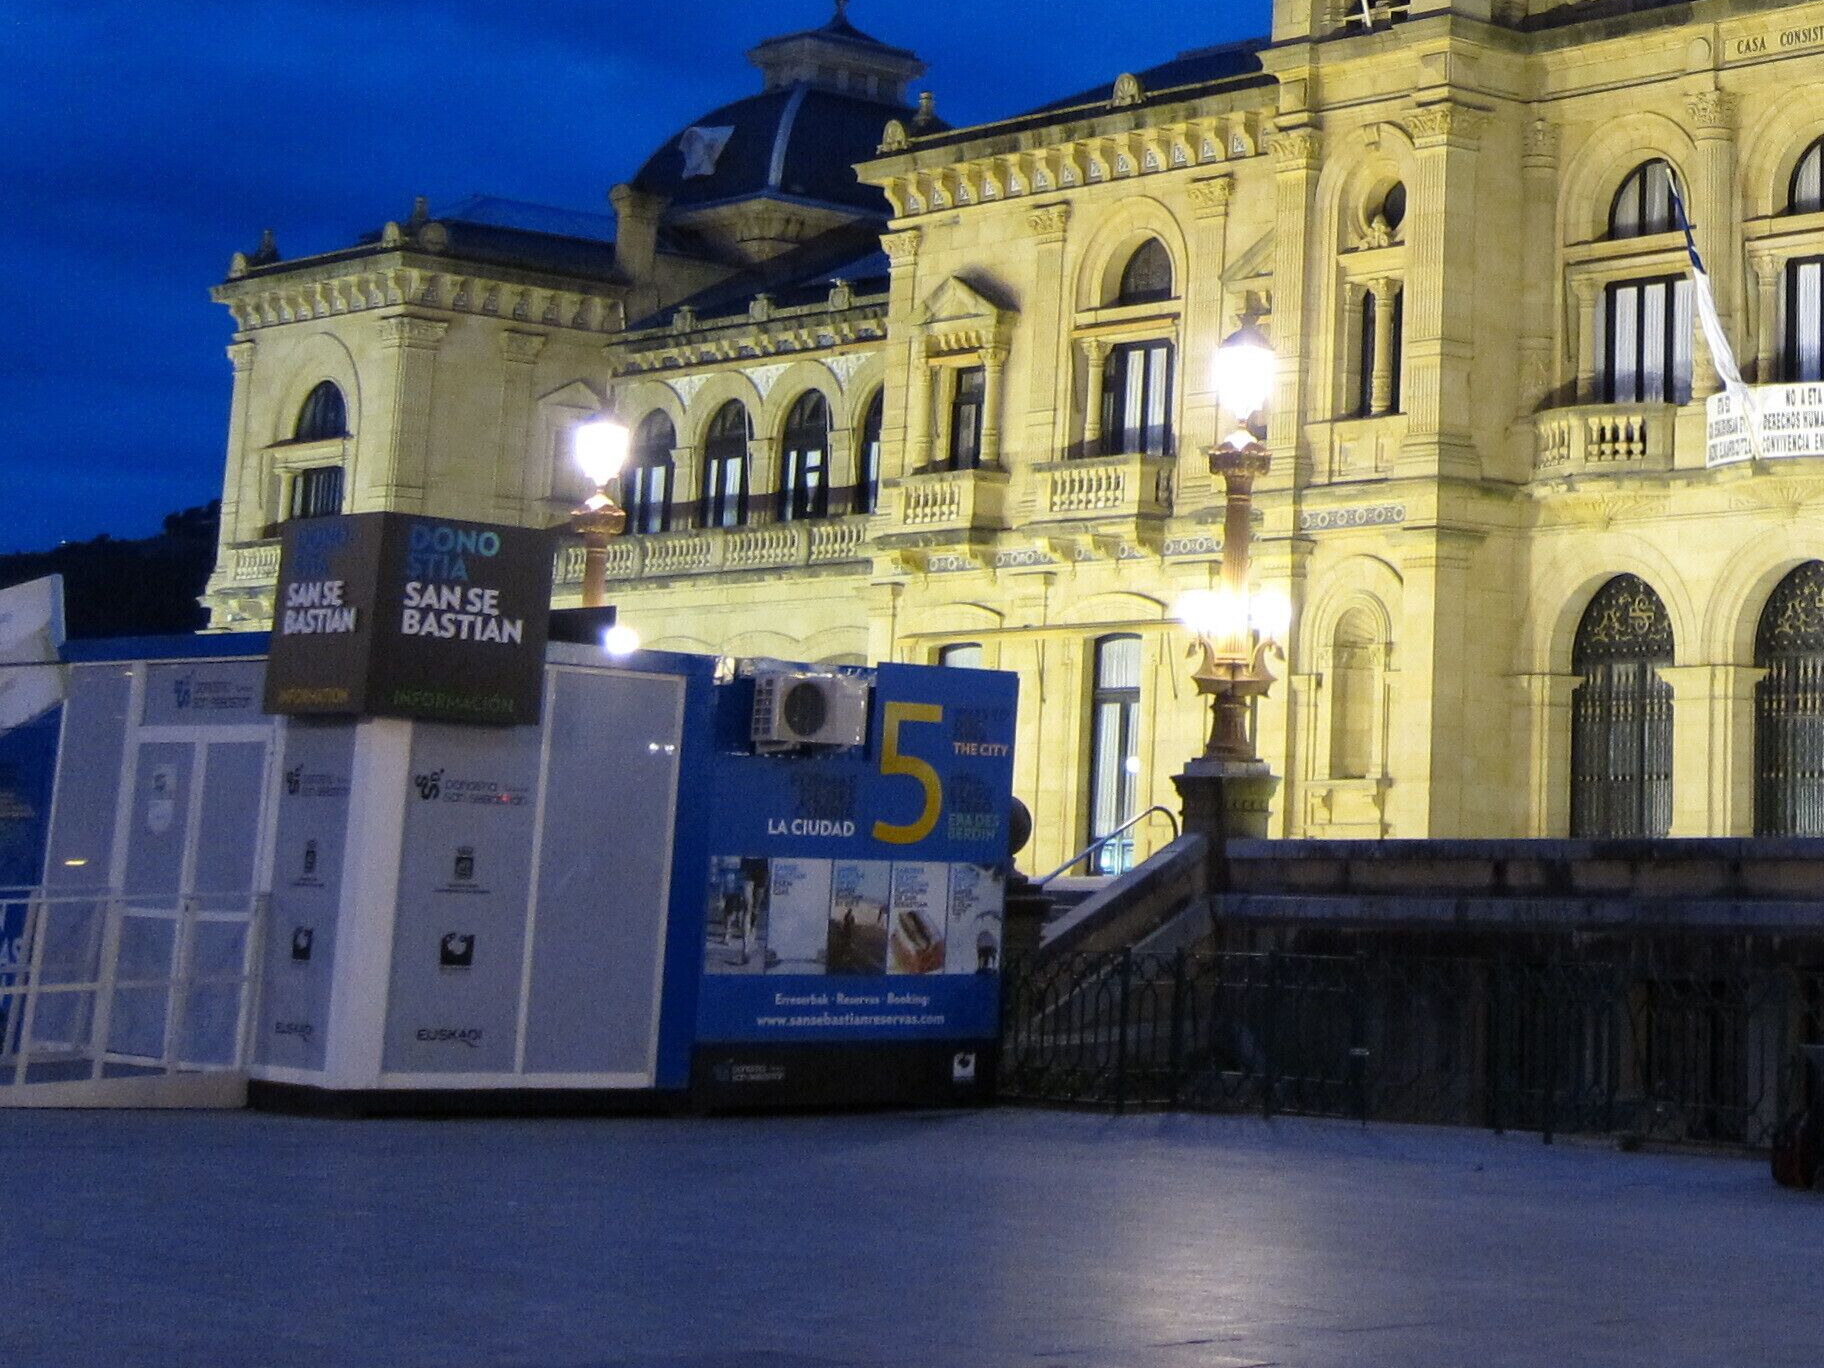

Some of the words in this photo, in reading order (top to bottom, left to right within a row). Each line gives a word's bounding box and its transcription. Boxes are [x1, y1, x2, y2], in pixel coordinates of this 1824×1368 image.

[1737, 36, 1766, 54] CASA
[1785, 388, 1797, 406] NO
[1808, 387, 1823, 405] ETA
[1762, 411, 1801, 430] DERECHOS
[1762, 433, 1810, 453] CONVIVENCIA
[1814, 433, 1824, 451] EN
[409, 523, 501, 558] DONO
[406, 553, 469, 581] STIA
[286, 581, 322, 608] SAN
[321, 580, 346, 606] SE
[402, 581, 462, 611] SAN
[465, 587, 501, 616] SE
[400, 610, 524, 645] BASTIAN
[952, 742, 978, 756] THE
[979, 742, 1010, 758] CITY
[872, 701, 944, 845] 5
[767, 818, 788, 835] LA
[790, 819, 856, 837] CIUDAD
[756, 1012, 945, 1027] www.sansebastianreservas.com
